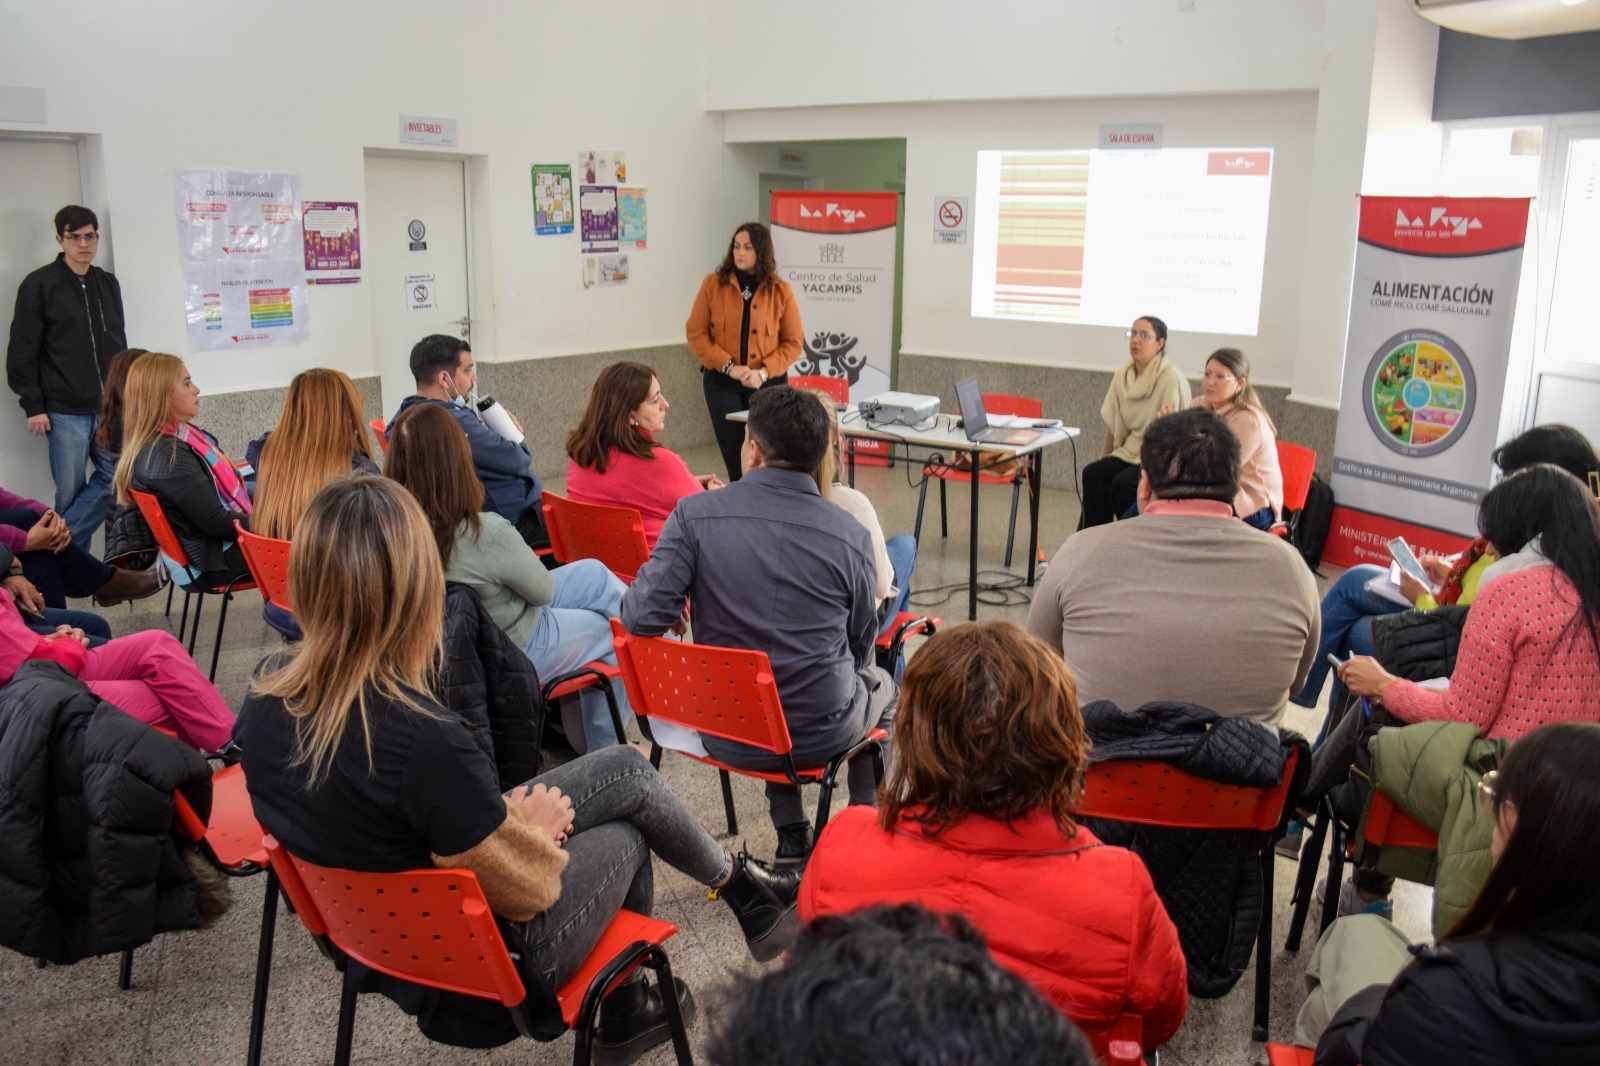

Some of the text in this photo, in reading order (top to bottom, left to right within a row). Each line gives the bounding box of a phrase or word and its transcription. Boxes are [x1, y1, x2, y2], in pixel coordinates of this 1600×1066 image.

[408, 121, 442, 134] INYECTABLES
[1109, 133, 1154, 144] SALA DE ESPERA
[187, 203, 226, 212] EGENCIA
[1394, 228, 1451, 239] provincia que late
[789, 271, 876, 283] Centro de Salud
[802, 283, 862, 294] YACAMPIS
[1372, 280, 1494, 305] ALIMENTACIÓN
[1371, 298, 1492, 316] COMÉ RICO, COMÉ SALUDABLE
[858, 440, 879, 449] RIOJA
[1338, 461, 1479, 499] Gráfica de la guía alimentaria Argentina
[1340, 526, 1390, 545] MINISTERI
